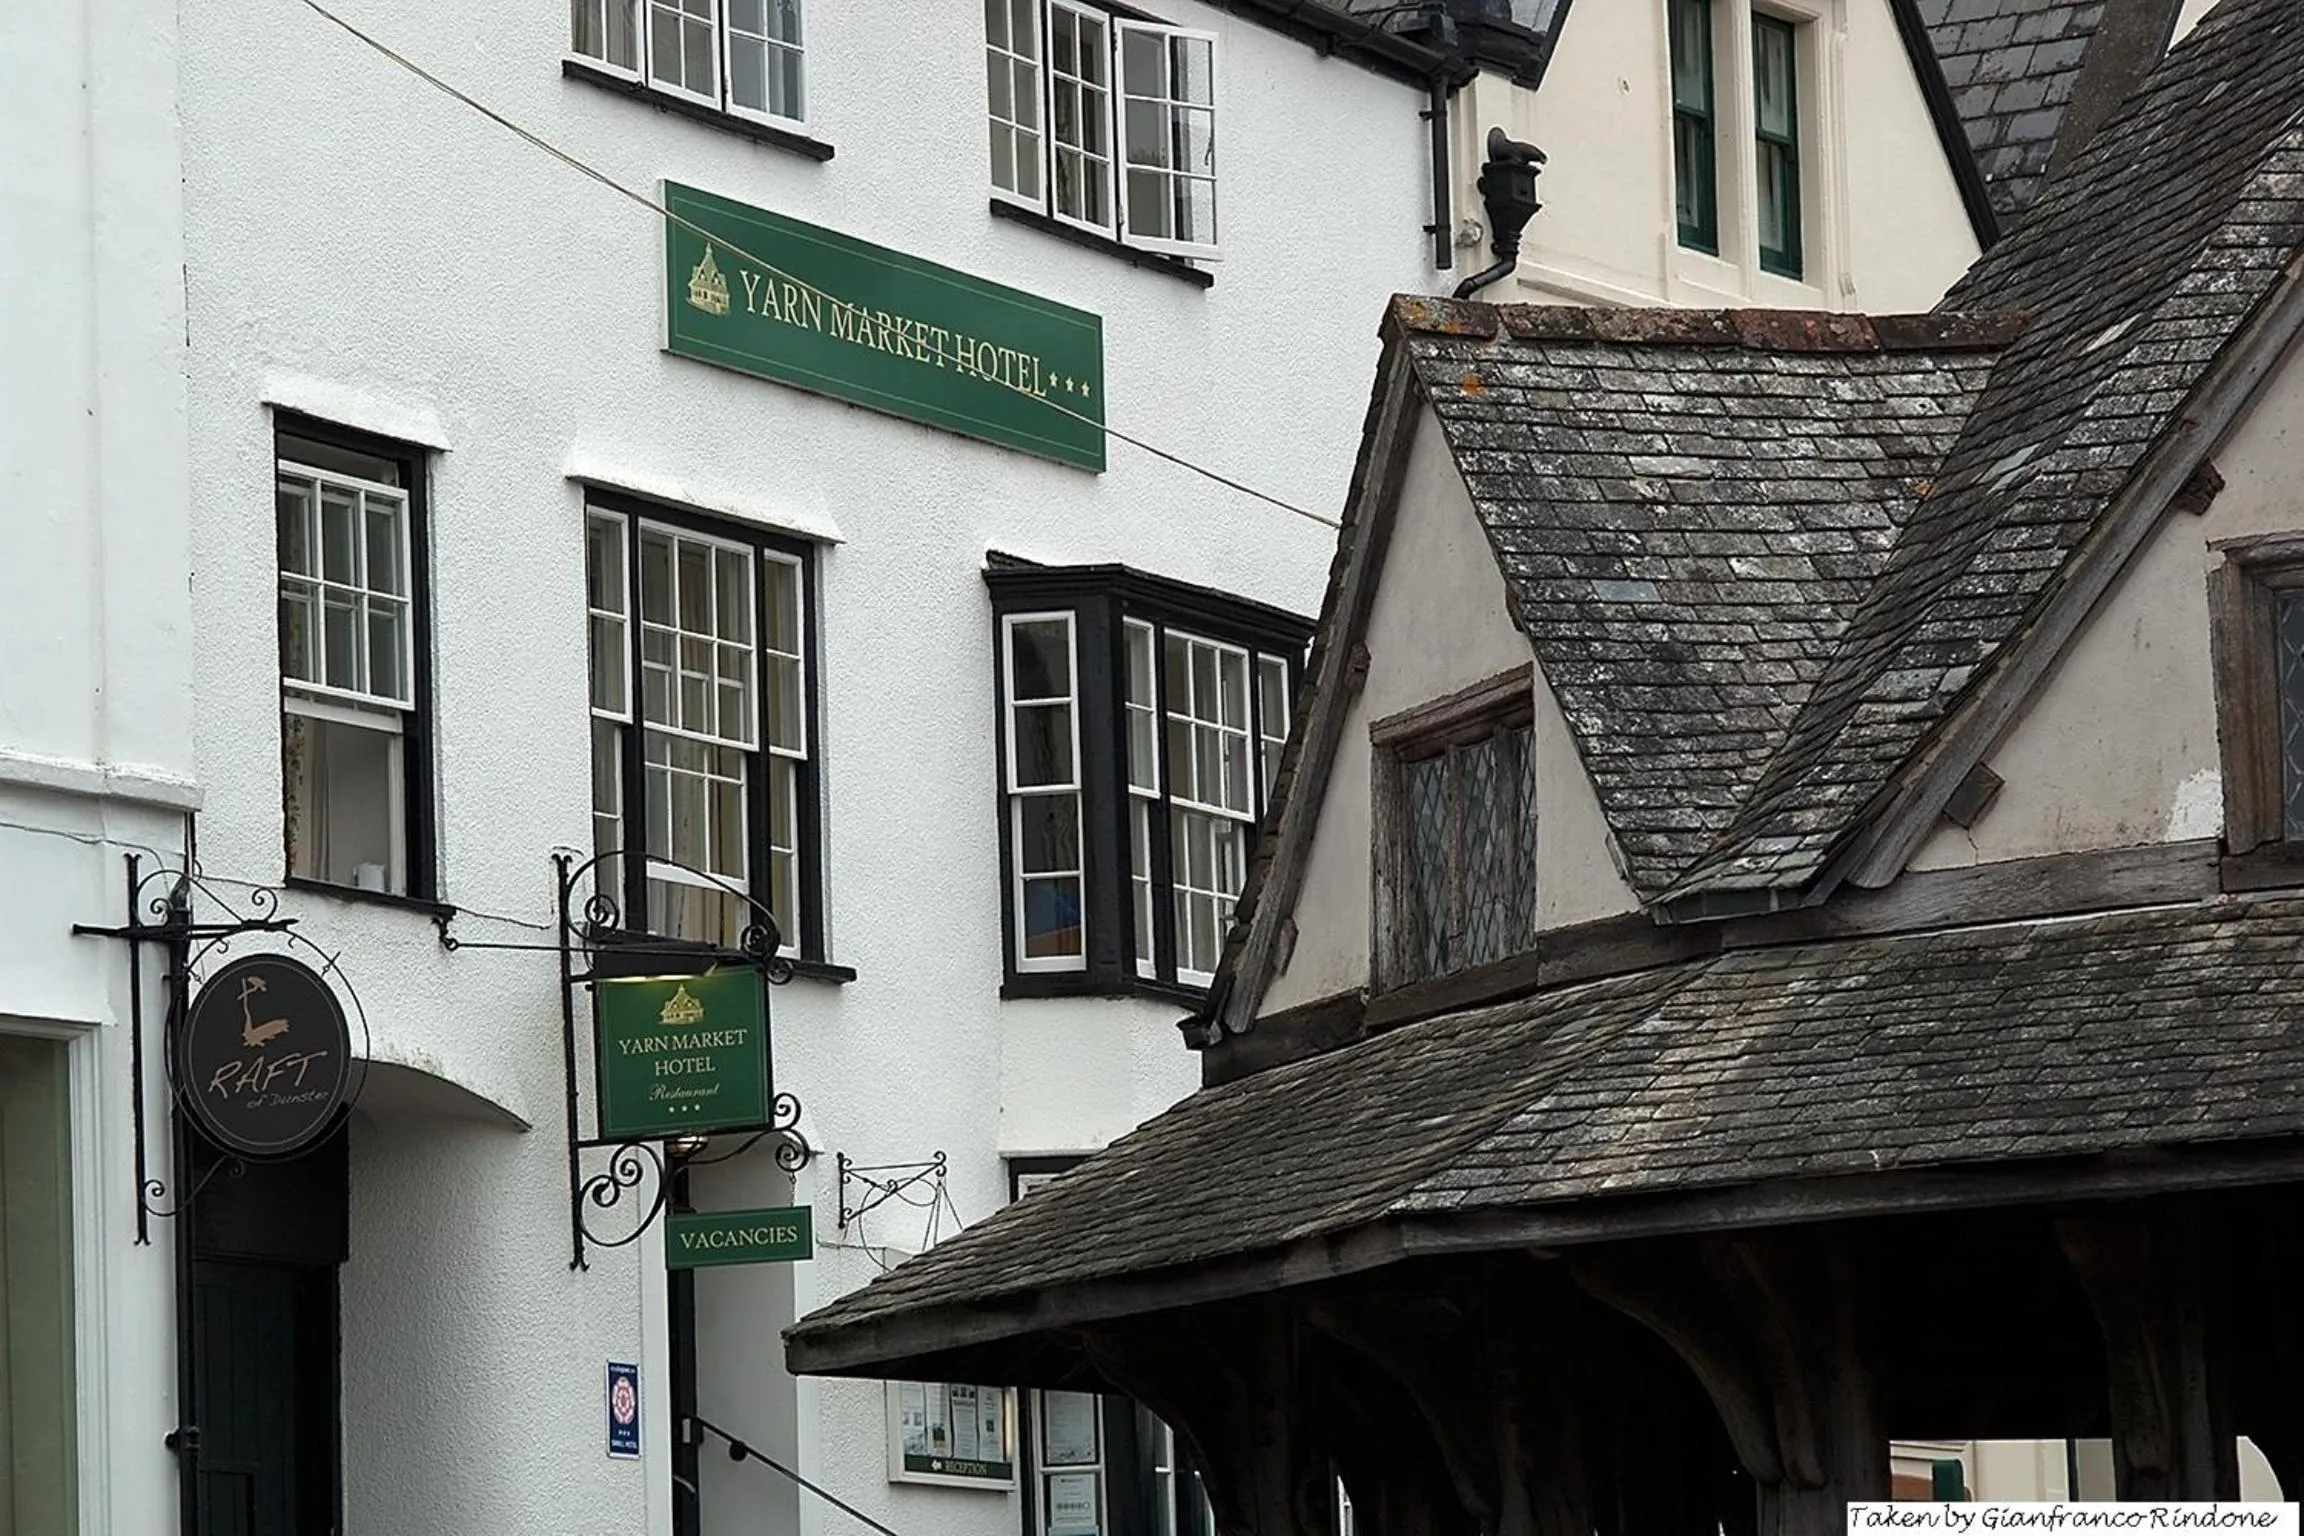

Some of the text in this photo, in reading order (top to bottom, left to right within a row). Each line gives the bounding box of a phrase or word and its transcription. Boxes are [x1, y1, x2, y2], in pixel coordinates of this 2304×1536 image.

[740, 269, 1047, 398] YARN MARKET HOTEL
[618, 1028, 748, 1055] YARN MARKET
[208, 1051, 328, 1098] RAFT
[654, 1057, 716, 1077] HOTEL
[246, 1093, 268, 1109] of
[649, 1083, 720, 1101] Restaurant
[680, 1226, 799, 1250] VACANCIES
